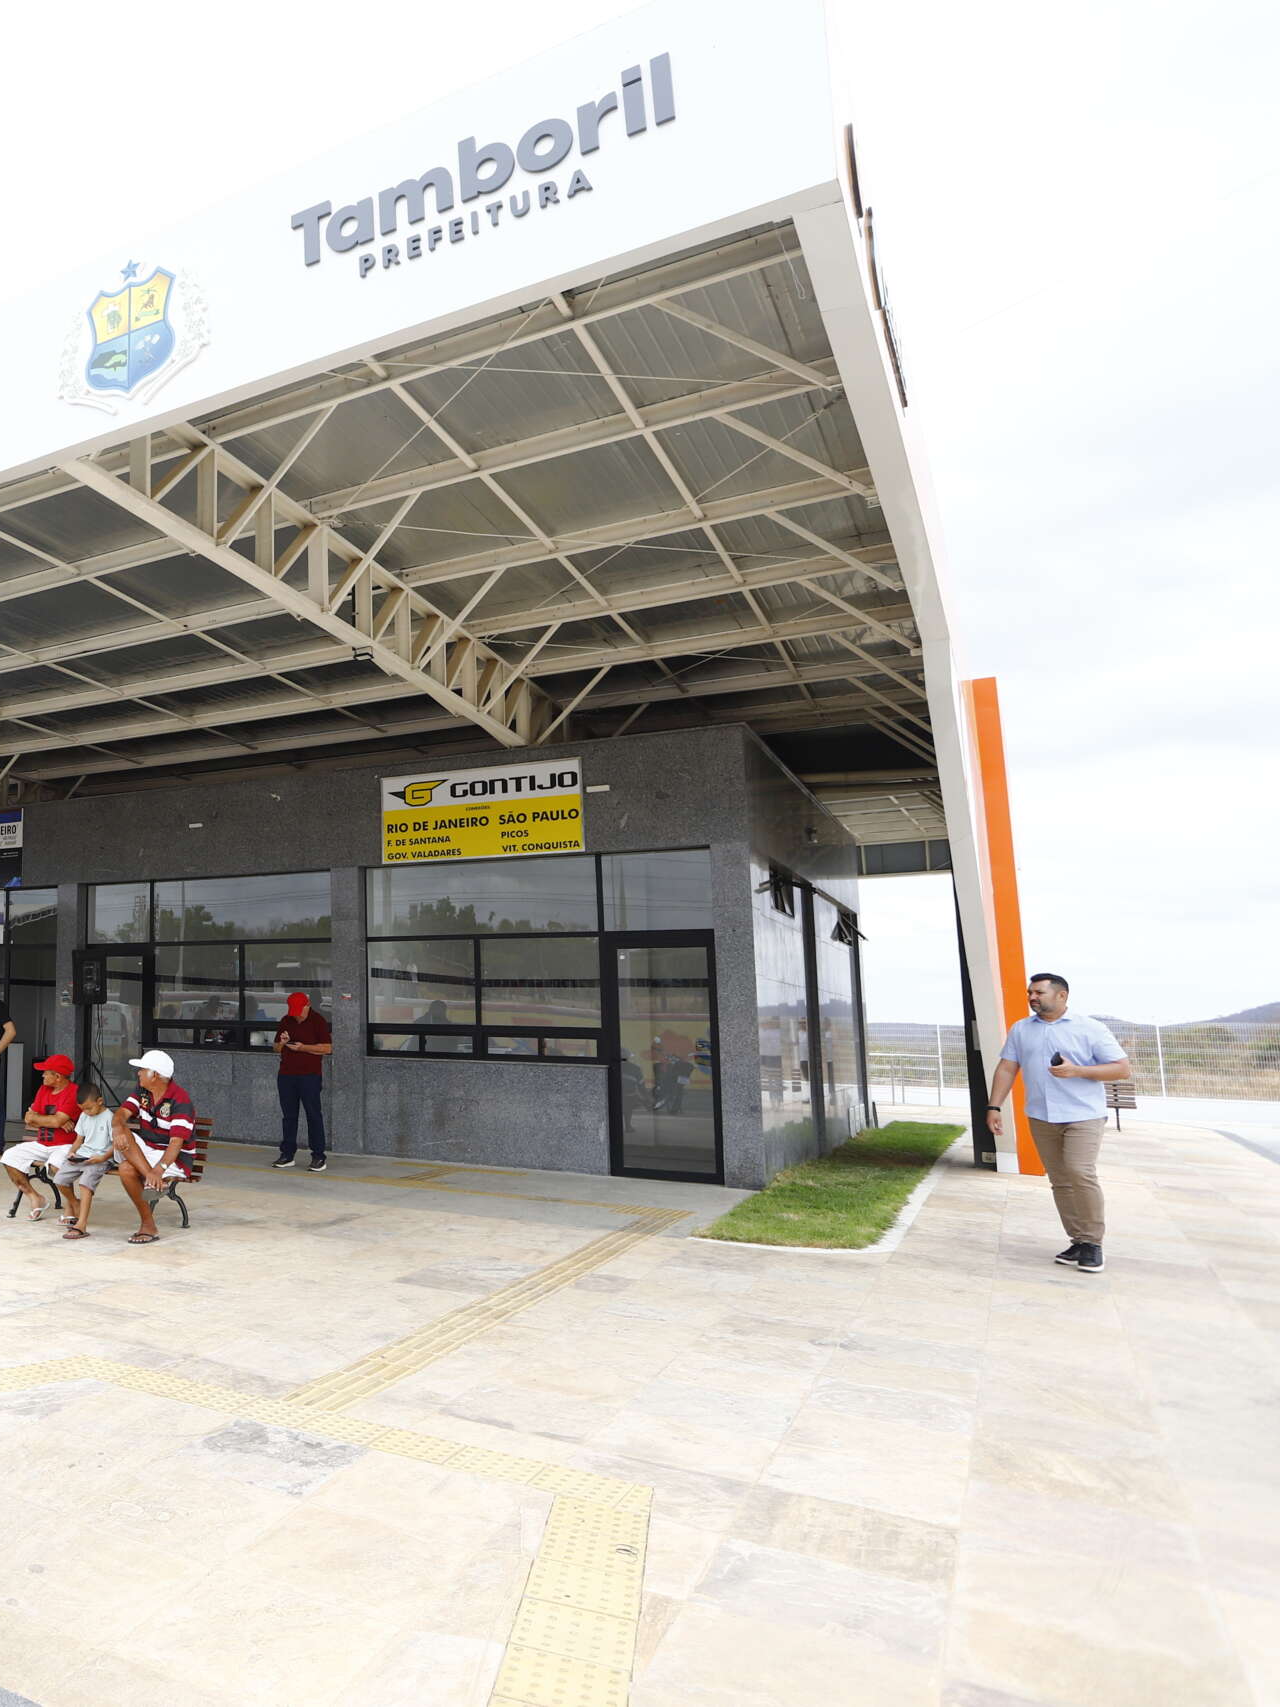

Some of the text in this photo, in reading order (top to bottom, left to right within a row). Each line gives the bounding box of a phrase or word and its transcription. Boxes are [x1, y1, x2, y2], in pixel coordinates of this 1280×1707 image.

[291, 51, 676, 267] Tamboril
[359, 169, 593, 278] PREFEITURA
[450, 771, 579, 799] GONTIJO
[387, 816, 490, 834] RIO DE JANEIRO
[498, 808, 580, 825] SÃO PAULO
[395, 838, 407, 847] DE
[408, 835, 451, 846] SANTANA
[500, 830, 529, 839] PICOS
[387, 848, 462, 860] GOV. VALADARES
[502, 840, 580, 852] VIT. CONQUISTA
